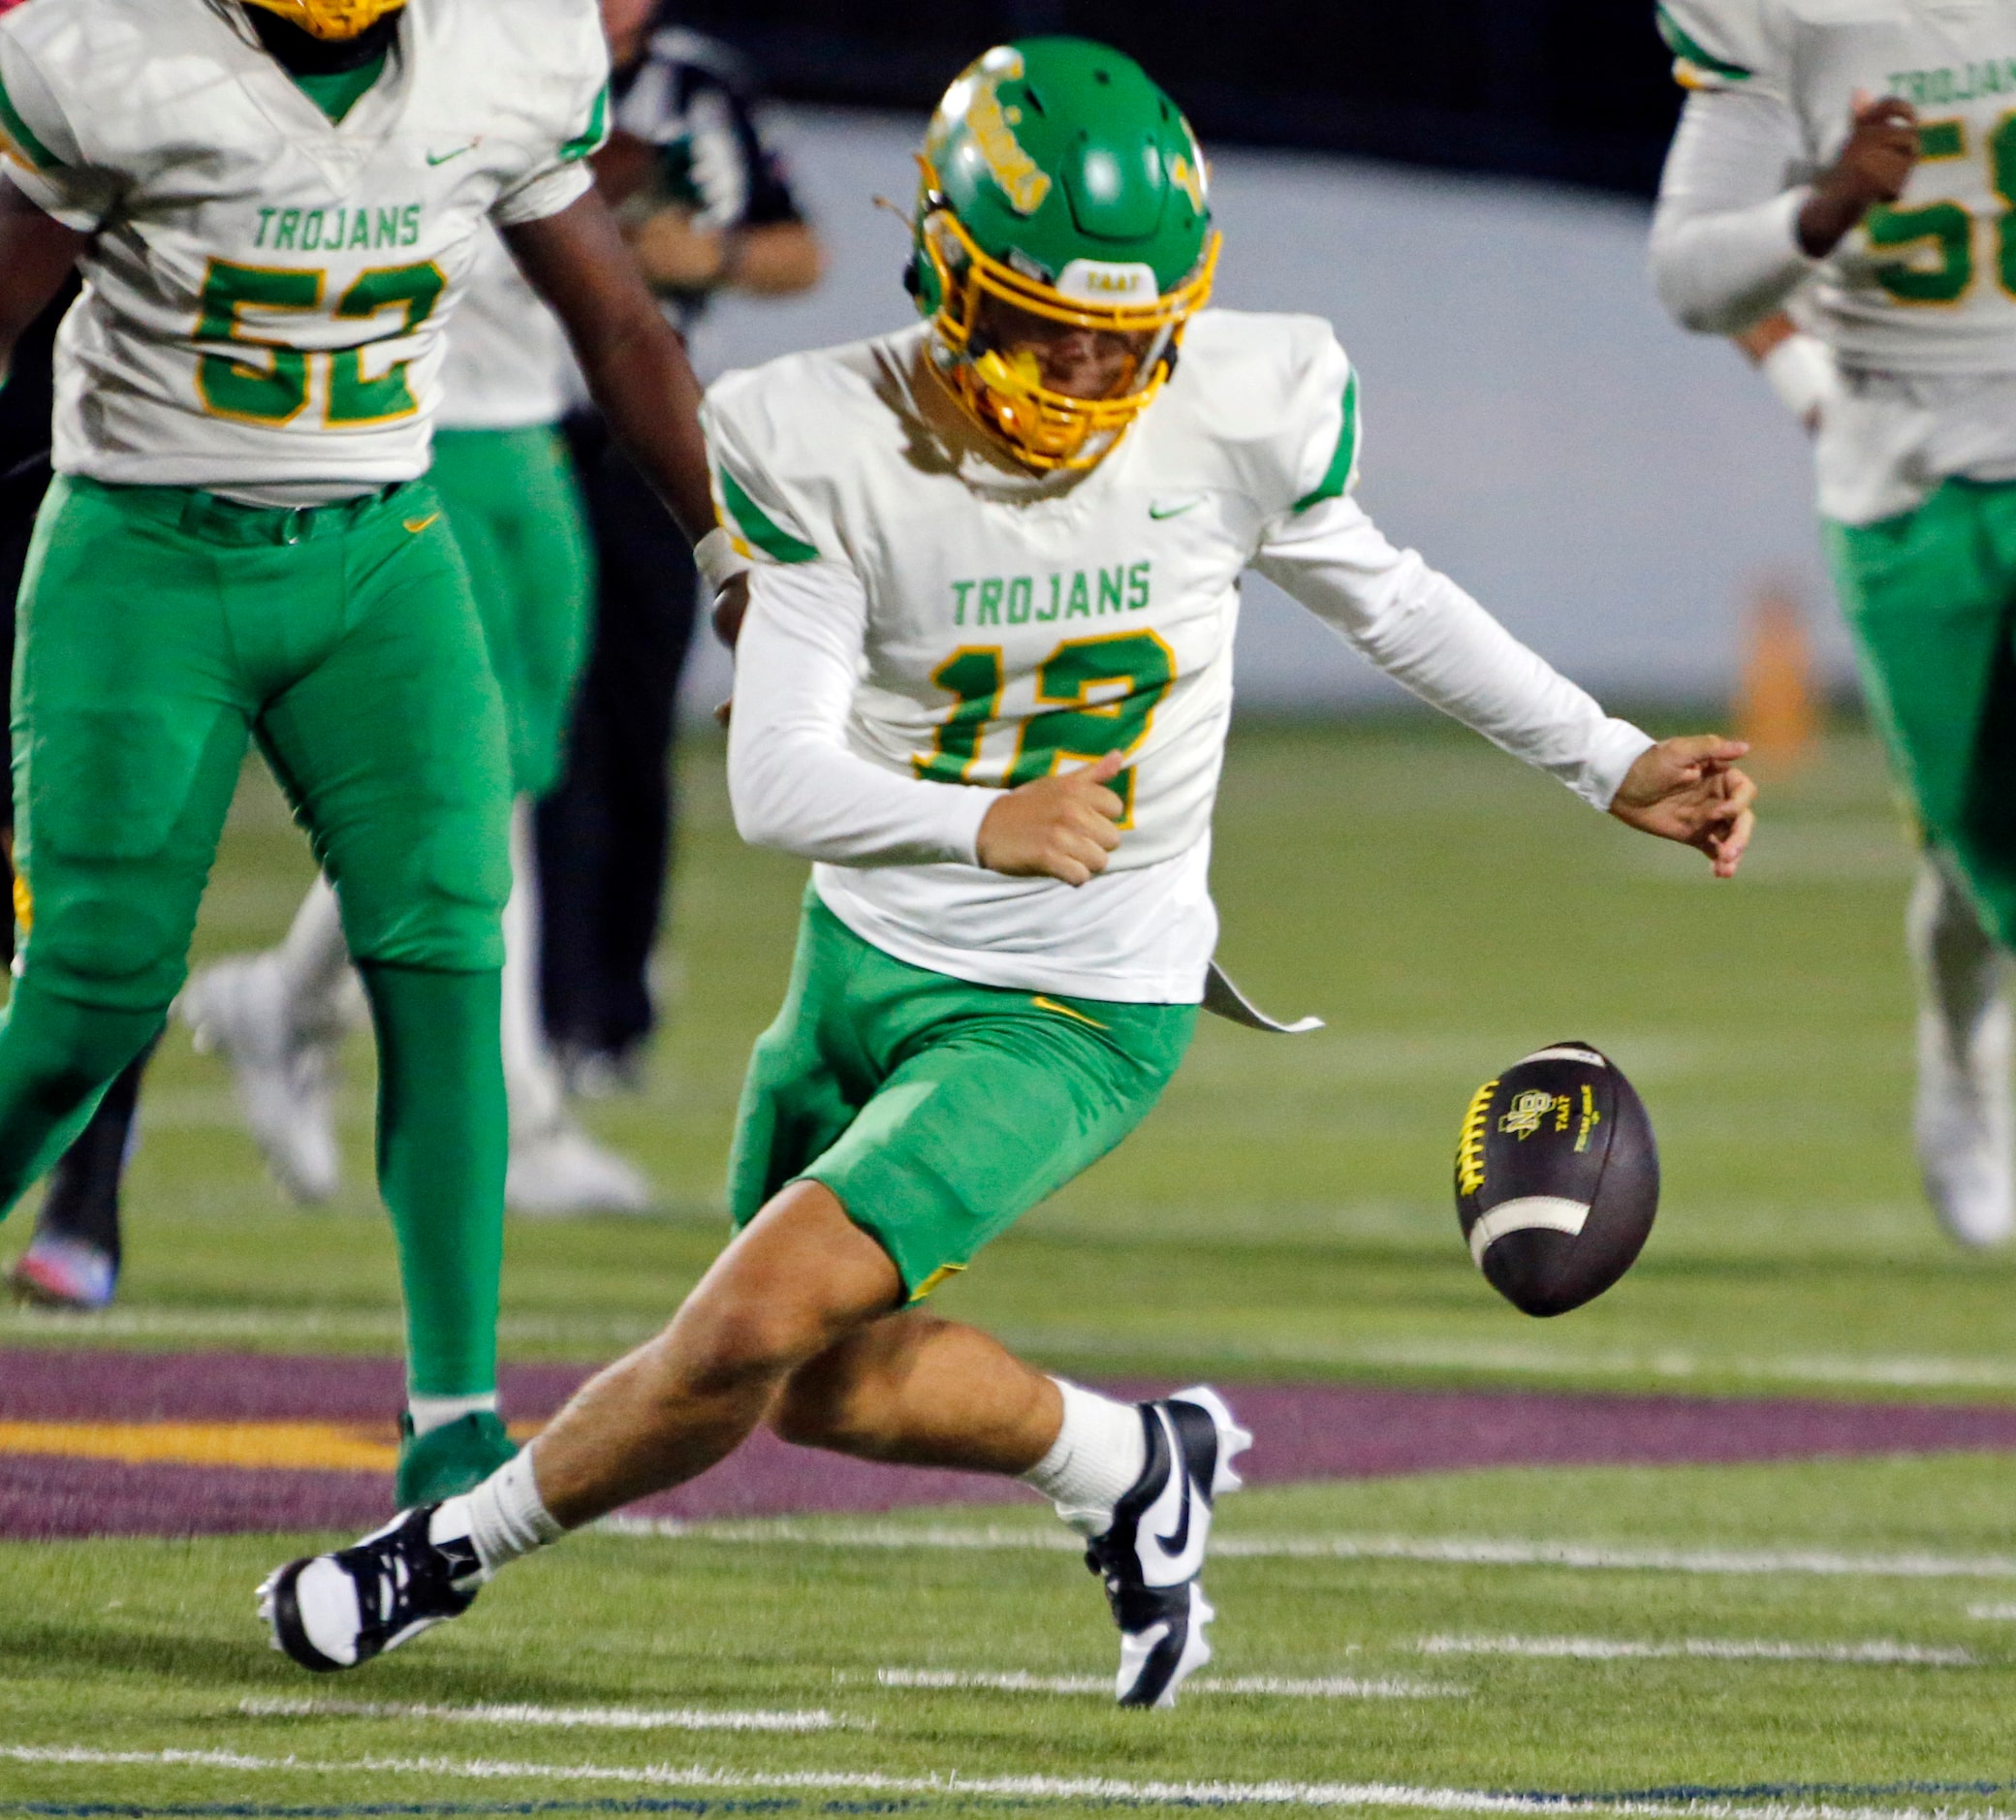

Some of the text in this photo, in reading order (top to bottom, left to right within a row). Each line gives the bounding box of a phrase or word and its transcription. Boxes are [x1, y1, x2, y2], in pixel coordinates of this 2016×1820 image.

[254, 204, 421, 250] TROJANS
[192, 258, 448, 429] 52
[951, 560, 1151, 626] TROJANS
[911, 627, 1177, 831] 12
